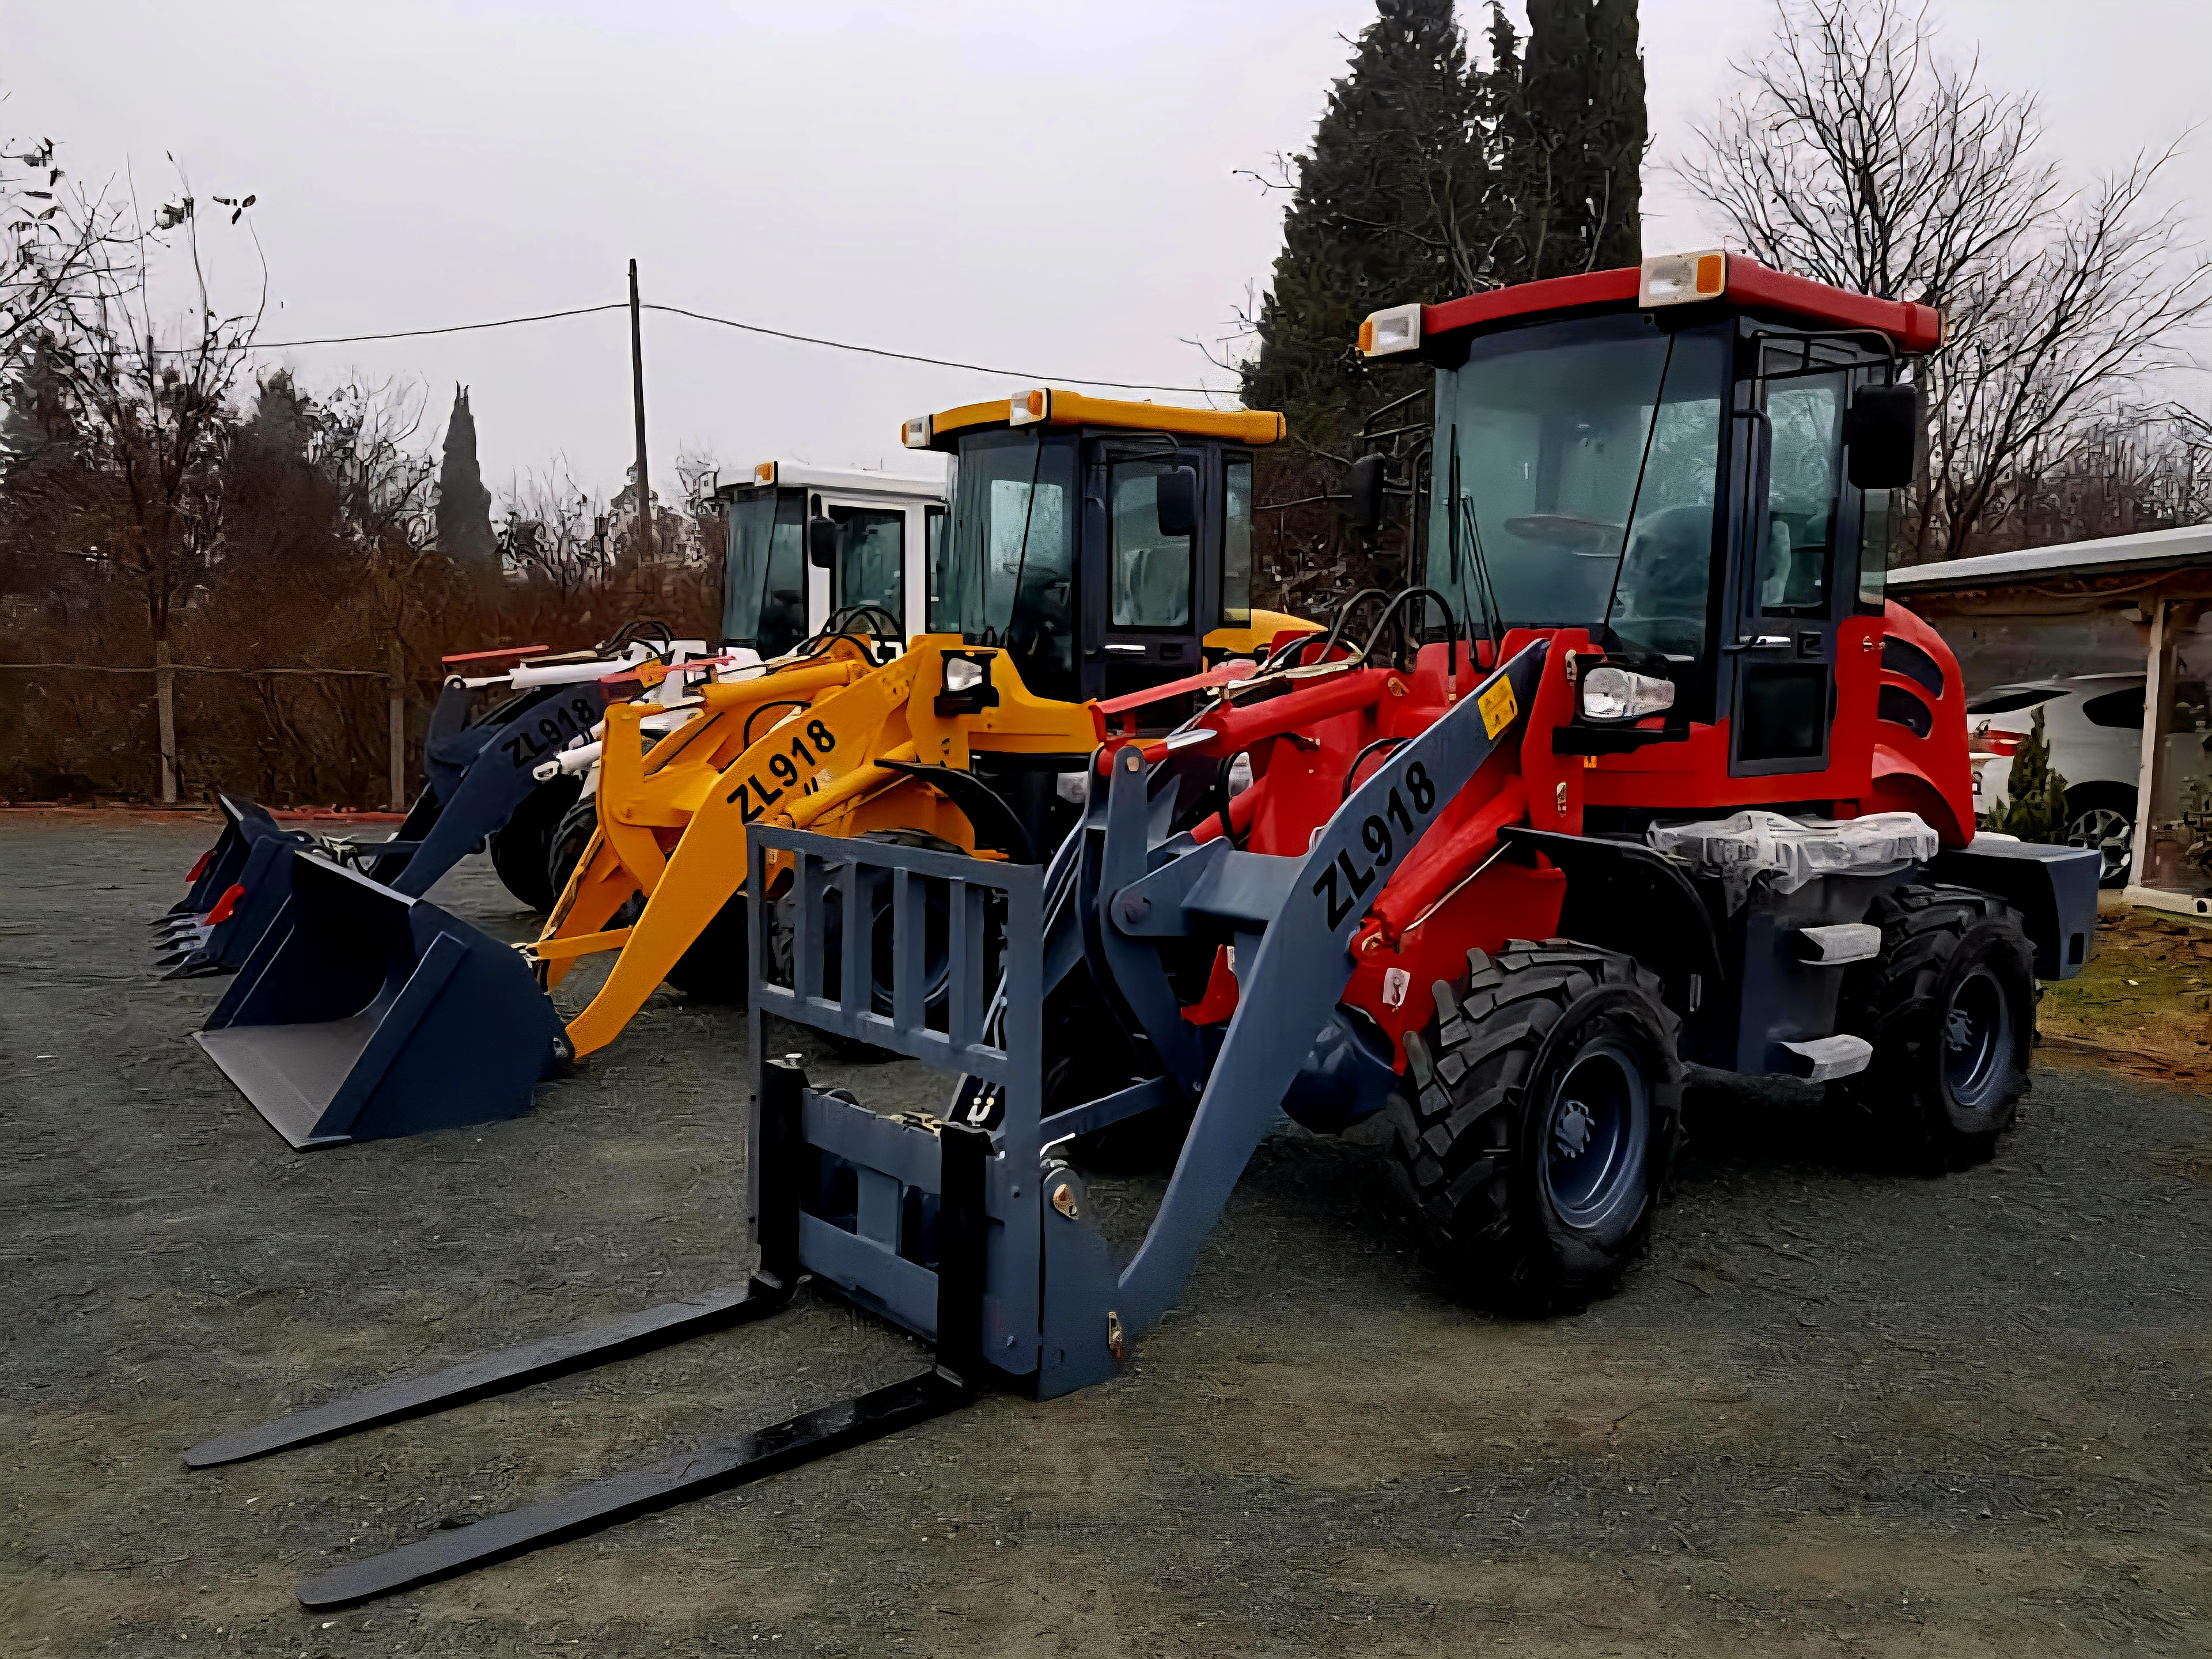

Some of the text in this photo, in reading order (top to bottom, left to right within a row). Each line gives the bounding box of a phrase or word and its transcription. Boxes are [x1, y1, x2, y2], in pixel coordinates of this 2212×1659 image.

[501, 699, 595, 768] ZL918
[726, 719, 835, 824] ZL918
[1313, 761, 1435, 932] ZL918
